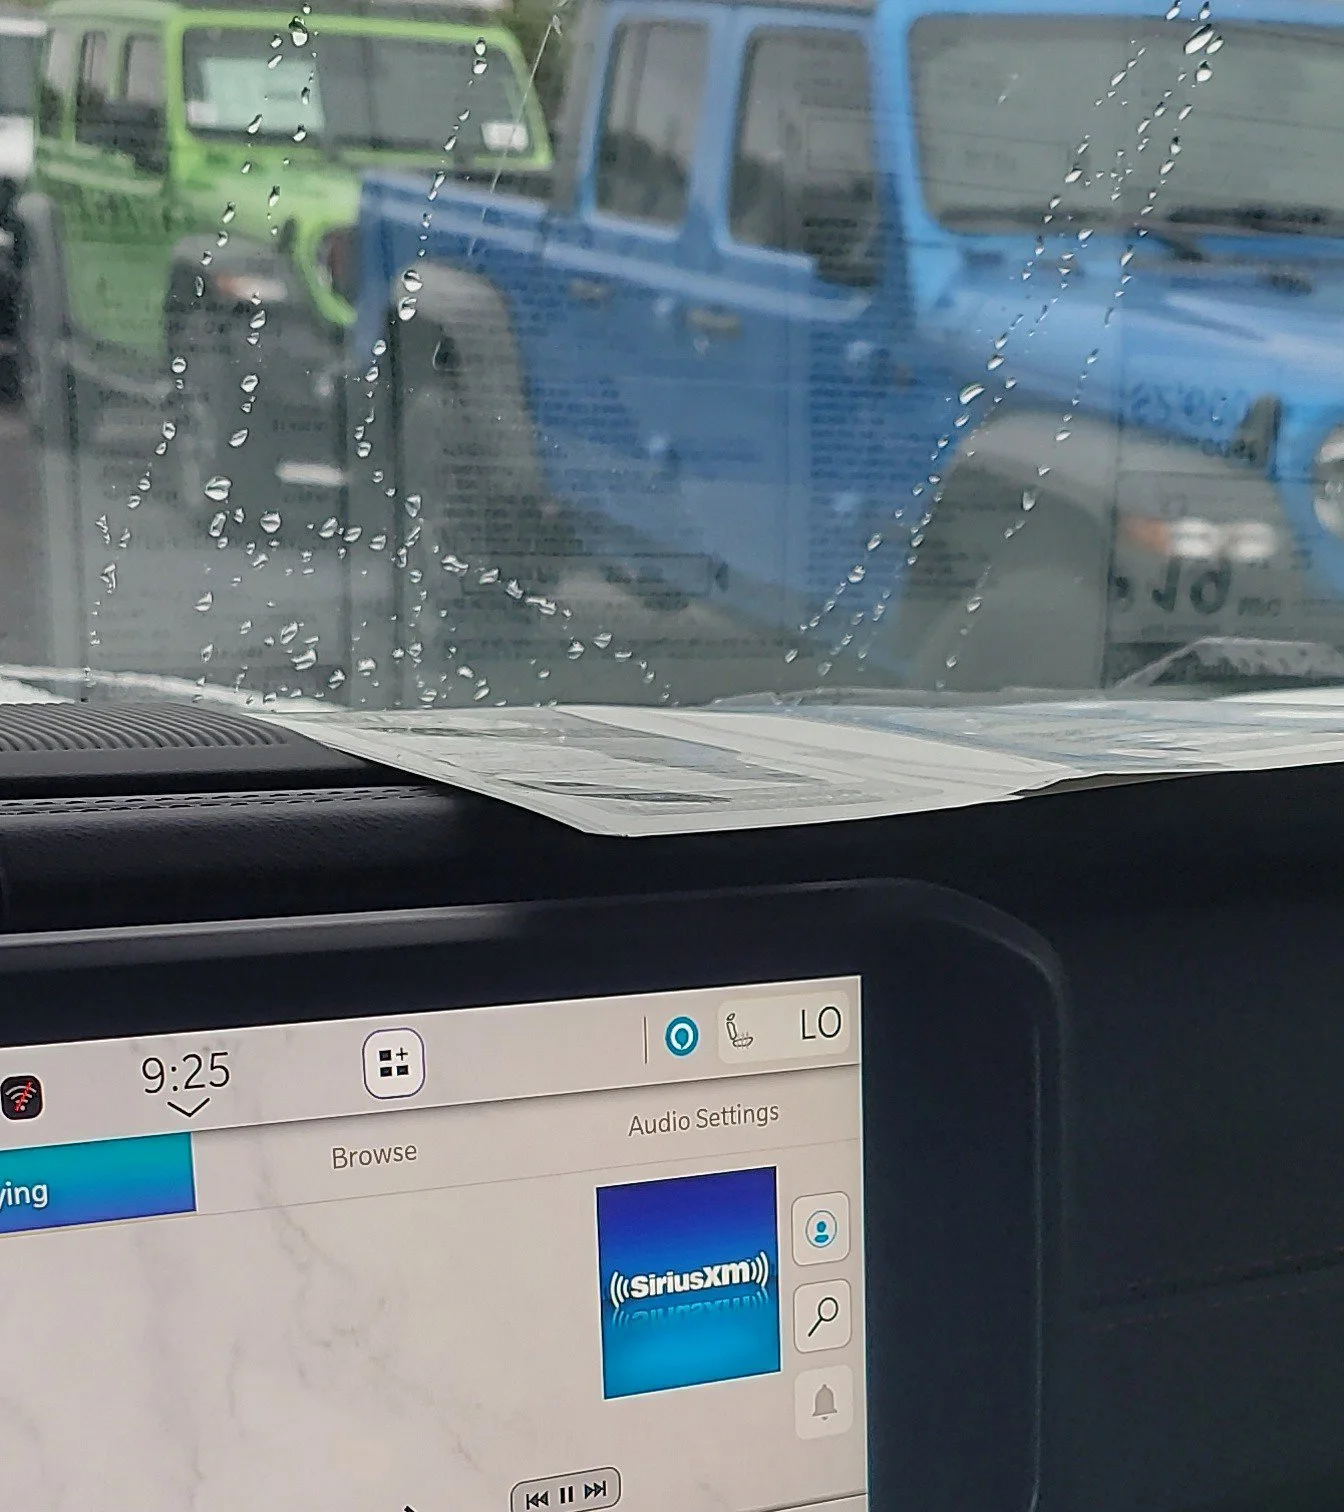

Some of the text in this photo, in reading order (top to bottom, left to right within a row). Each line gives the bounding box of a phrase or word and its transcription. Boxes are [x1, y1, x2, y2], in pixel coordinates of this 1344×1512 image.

[800, 1005, 843, 1042] LO
[140, 1050, 232, 1095] 9:25
[628, 1101, 780, 1137] Audio Settings
[331, 1142, 419, 1170] Browse
